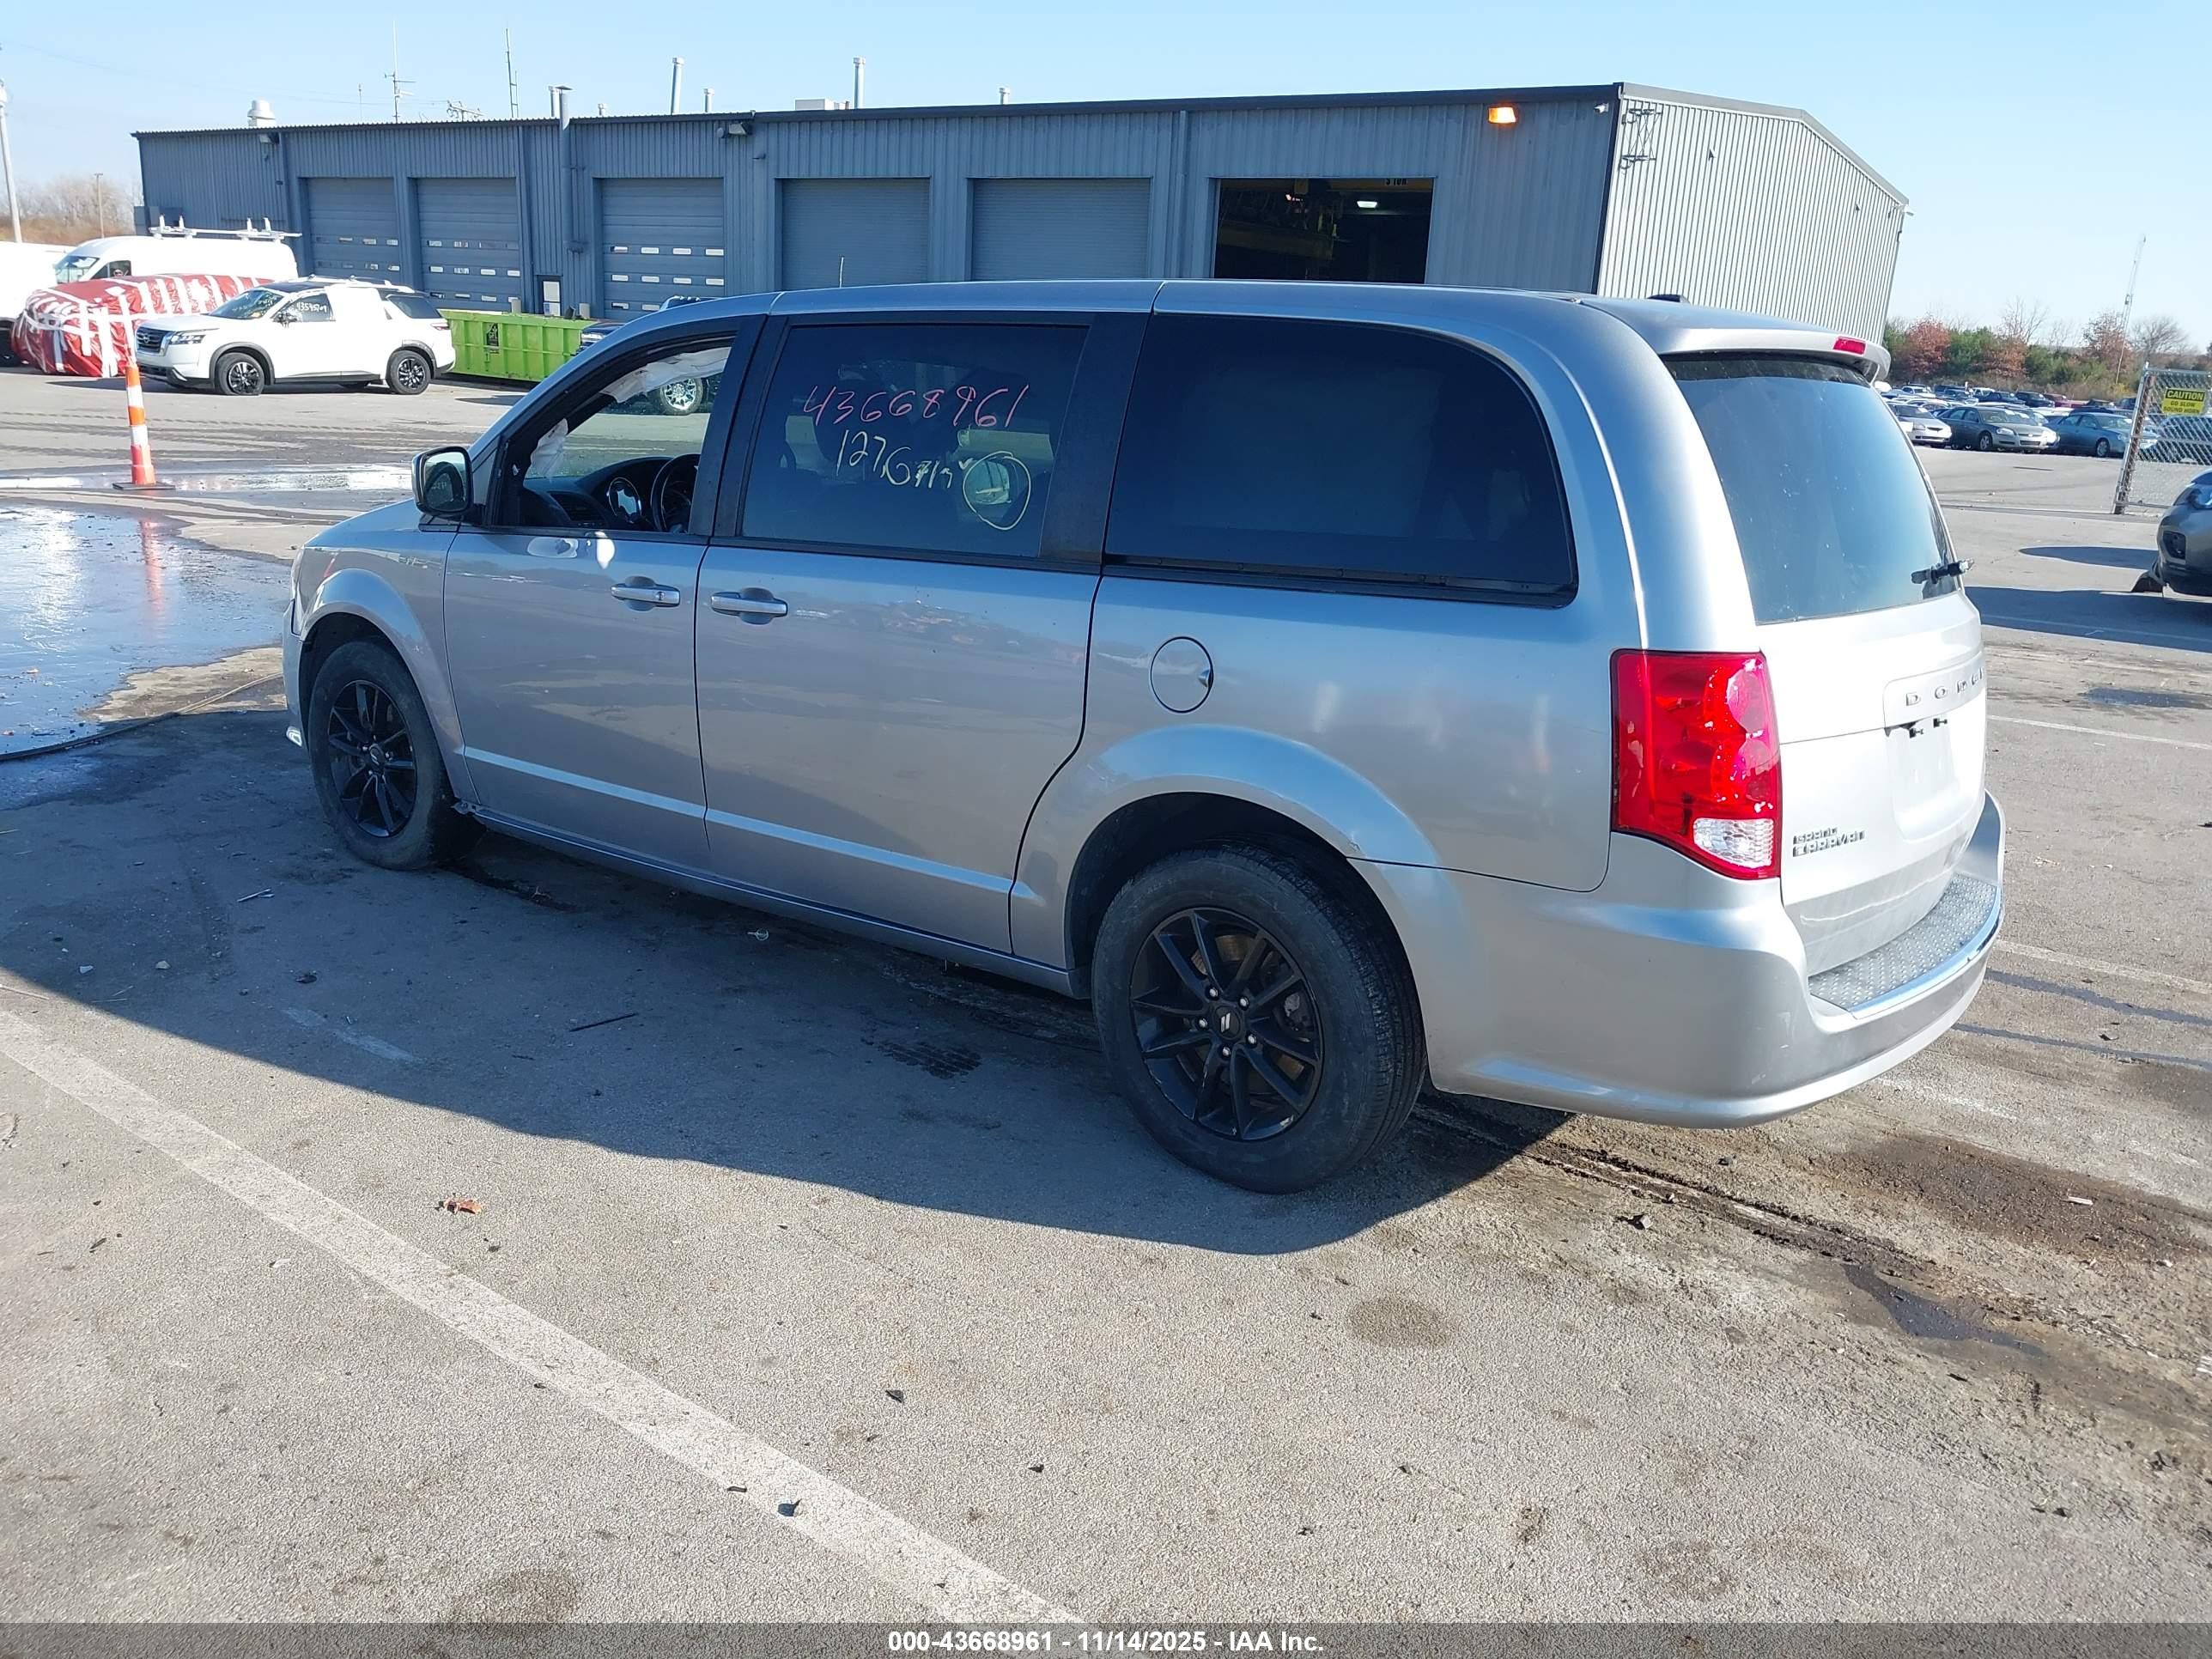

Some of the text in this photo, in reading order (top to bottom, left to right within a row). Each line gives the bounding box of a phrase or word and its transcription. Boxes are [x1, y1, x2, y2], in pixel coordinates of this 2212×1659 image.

[802, 384, 1030, 427] 43668961
[2166, 390, 2204, 401] CAUTION
[1792, 830, 1866, 858] CARAVAN
